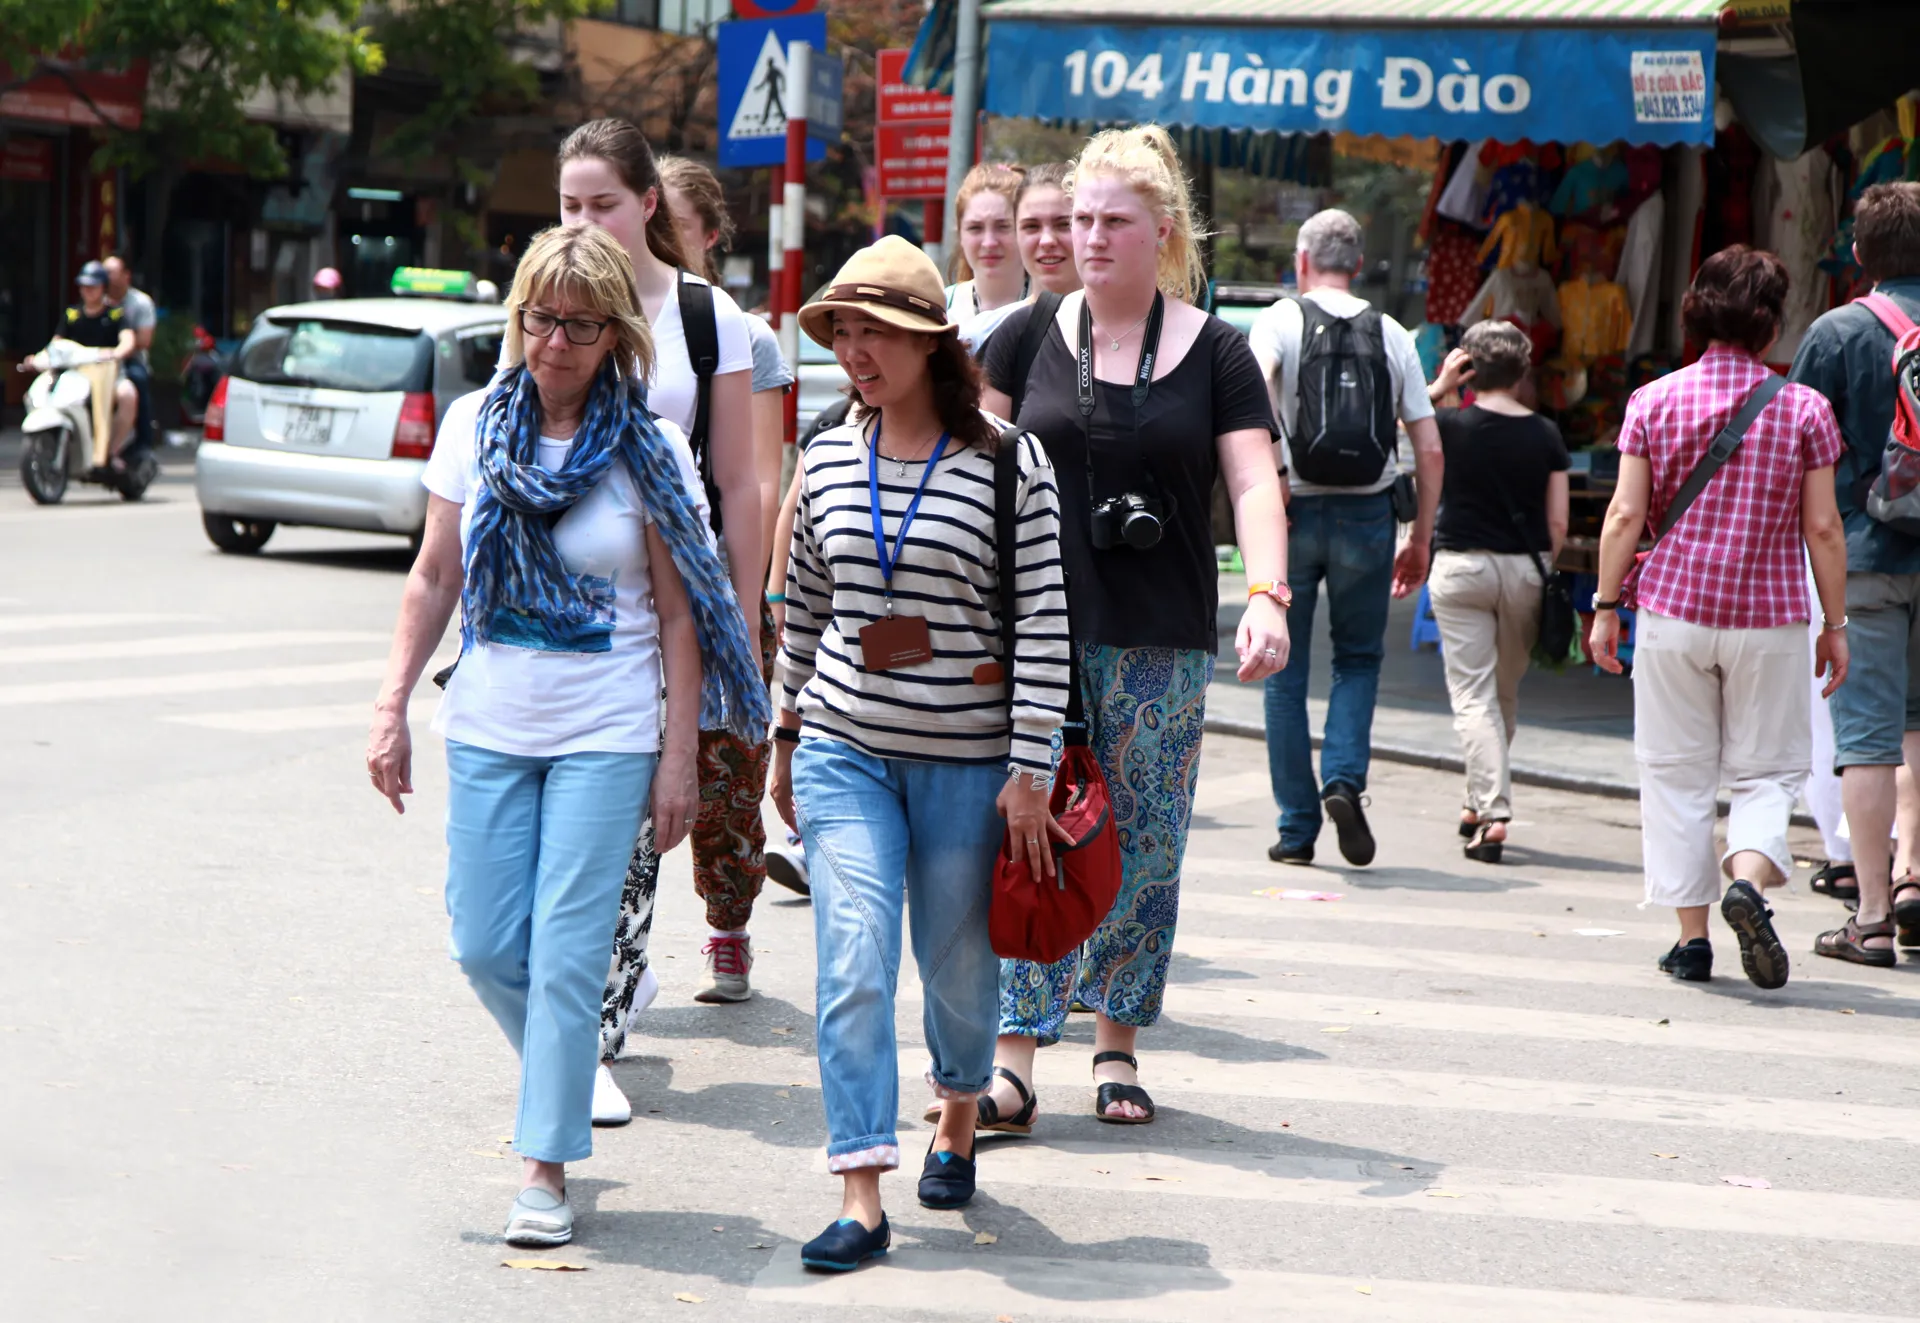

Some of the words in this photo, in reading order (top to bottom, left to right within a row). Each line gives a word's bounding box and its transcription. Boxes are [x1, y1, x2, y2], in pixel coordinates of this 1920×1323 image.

[1064, 50, 1164, 98] 104
[1180, 52, 1352, 119] Hàng
[1377, 57, 1532, 114] Đào
[1081, 347, 1089, 387] COOLPIX
[1140, 353, 1152, 379] Nikon
